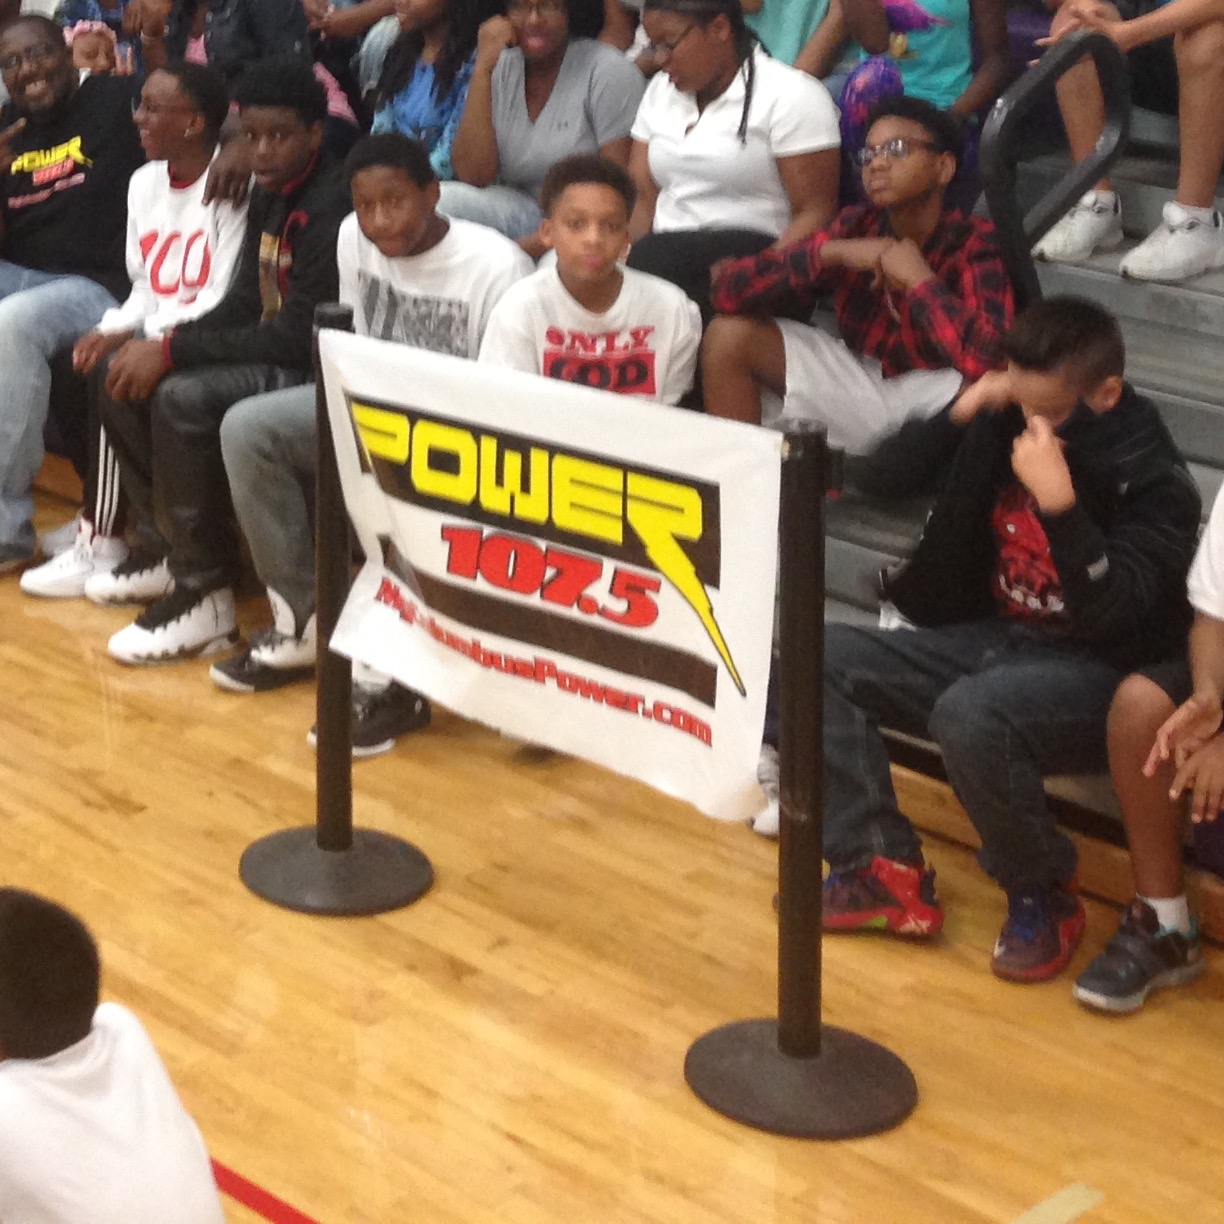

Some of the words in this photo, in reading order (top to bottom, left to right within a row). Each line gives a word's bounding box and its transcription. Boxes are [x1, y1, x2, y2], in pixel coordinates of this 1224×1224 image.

[11, 136, 93, 175] POWER
[546, 325, 655, 353] ONLY
[550, 356, 649, 390] GOD
[441, 524, 662, 628] 107.5
[375, 576, 712, 747] MylumbusPower.com
